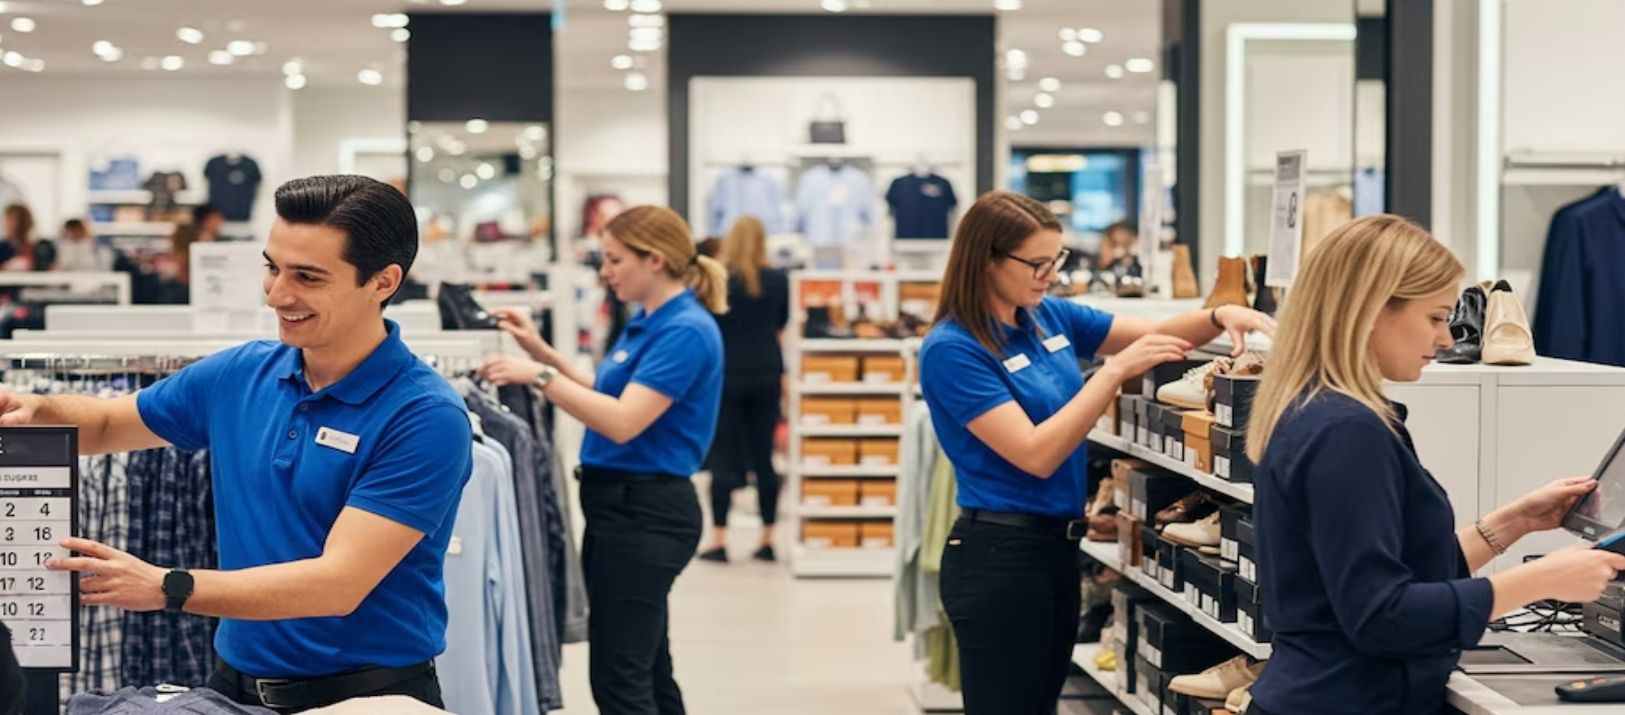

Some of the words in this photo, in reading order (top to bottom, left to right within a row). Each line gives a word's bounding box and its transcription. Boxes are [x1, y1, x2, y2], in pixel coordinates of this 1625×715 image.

[5, 502, 15, 517] 2
[40, 503, 50, 516] 4
[0, 552, 17, 566] 10
[26, 577, 45, 590] 12
[1, 602, 17, 616] 10
[27, 602, 45, 616] 12
